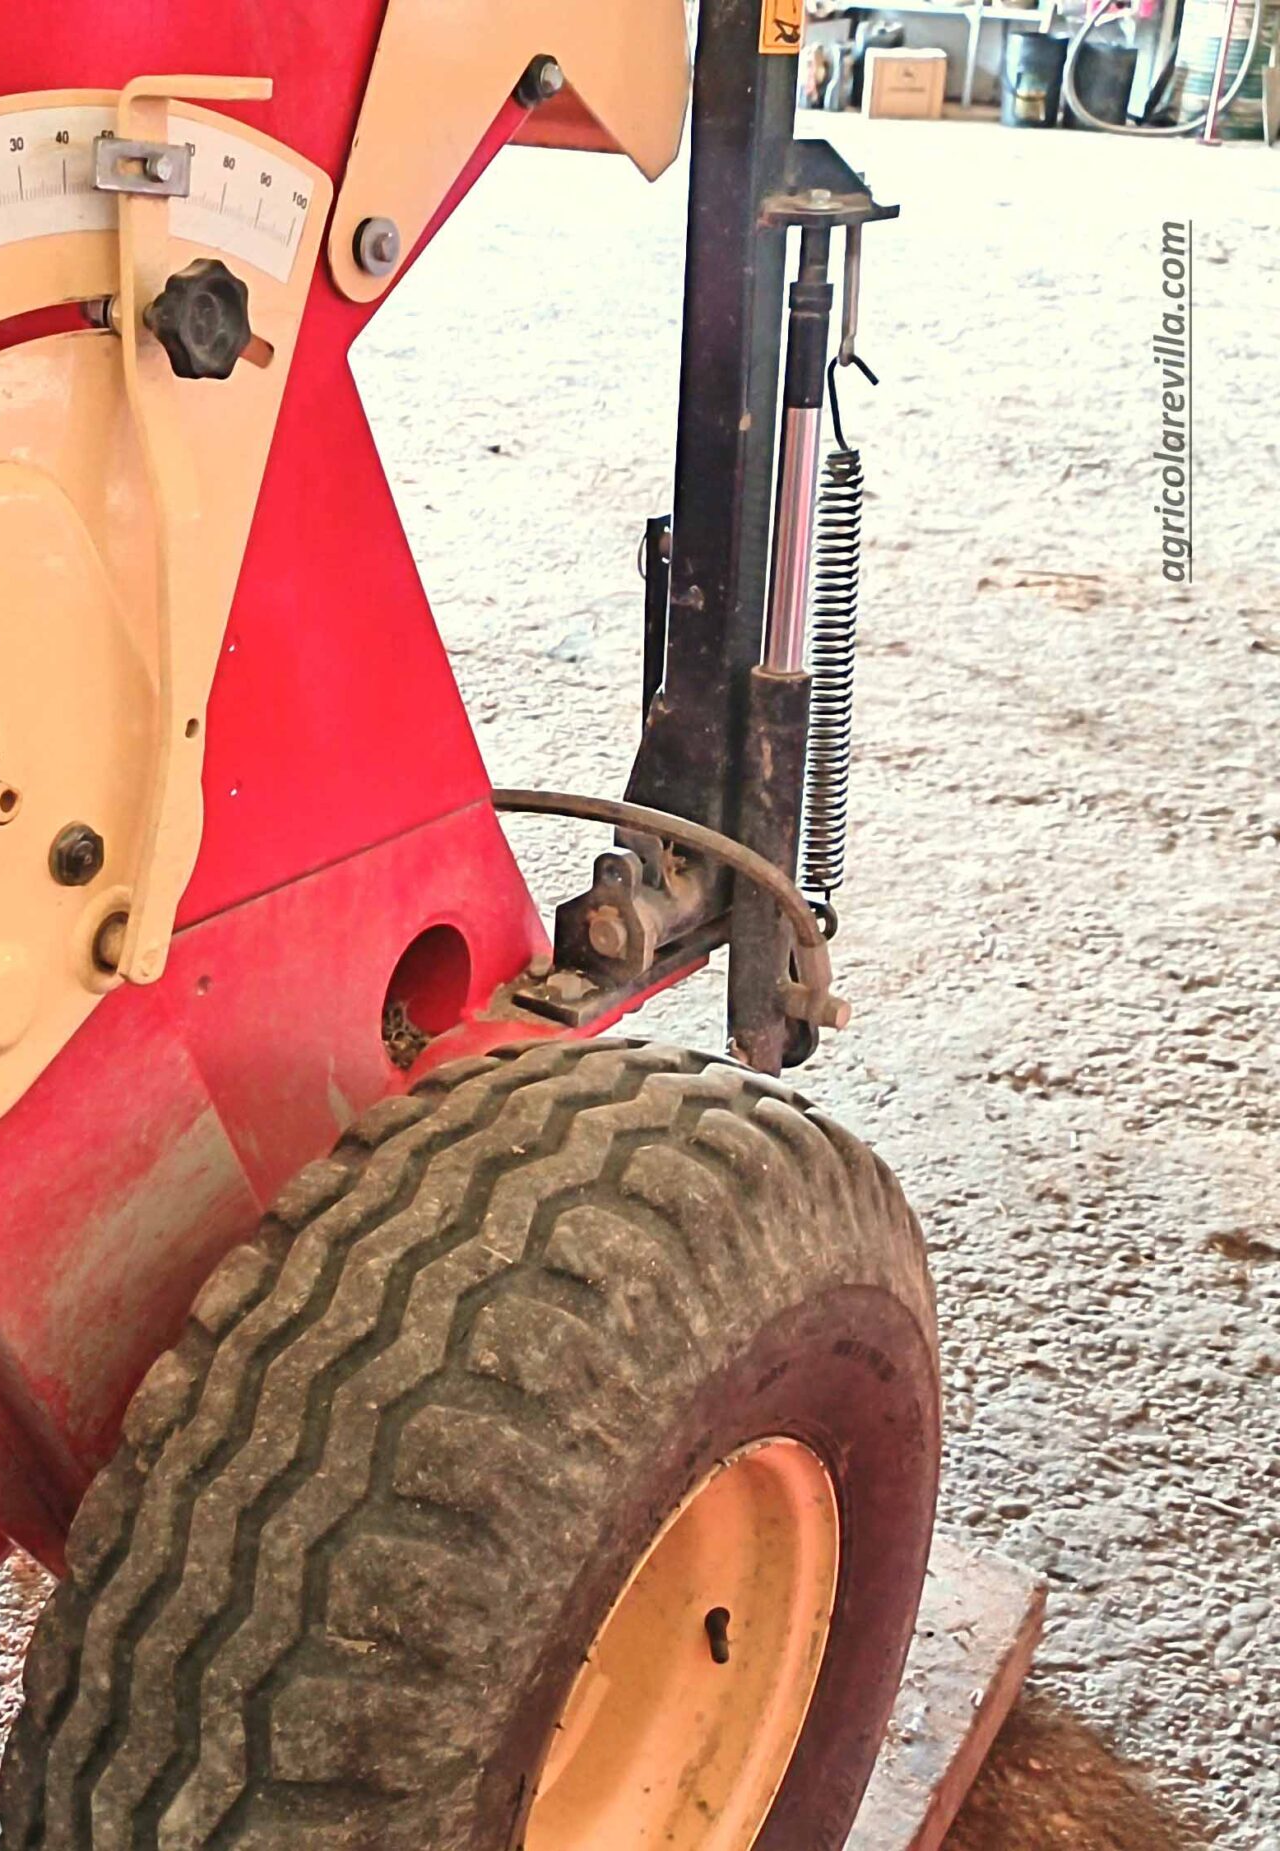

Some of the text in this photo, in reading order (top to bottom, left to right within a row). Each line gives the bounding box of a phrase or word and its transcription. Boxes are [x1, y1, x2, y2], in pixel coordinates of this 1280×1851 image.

[9, 137, 24, 152] 30
[55, 130, 69, 144] 40
[223, 155, 236, 170] 80
[260, 172, 272, 187] 90
[292, 191, 308, 209] 100
